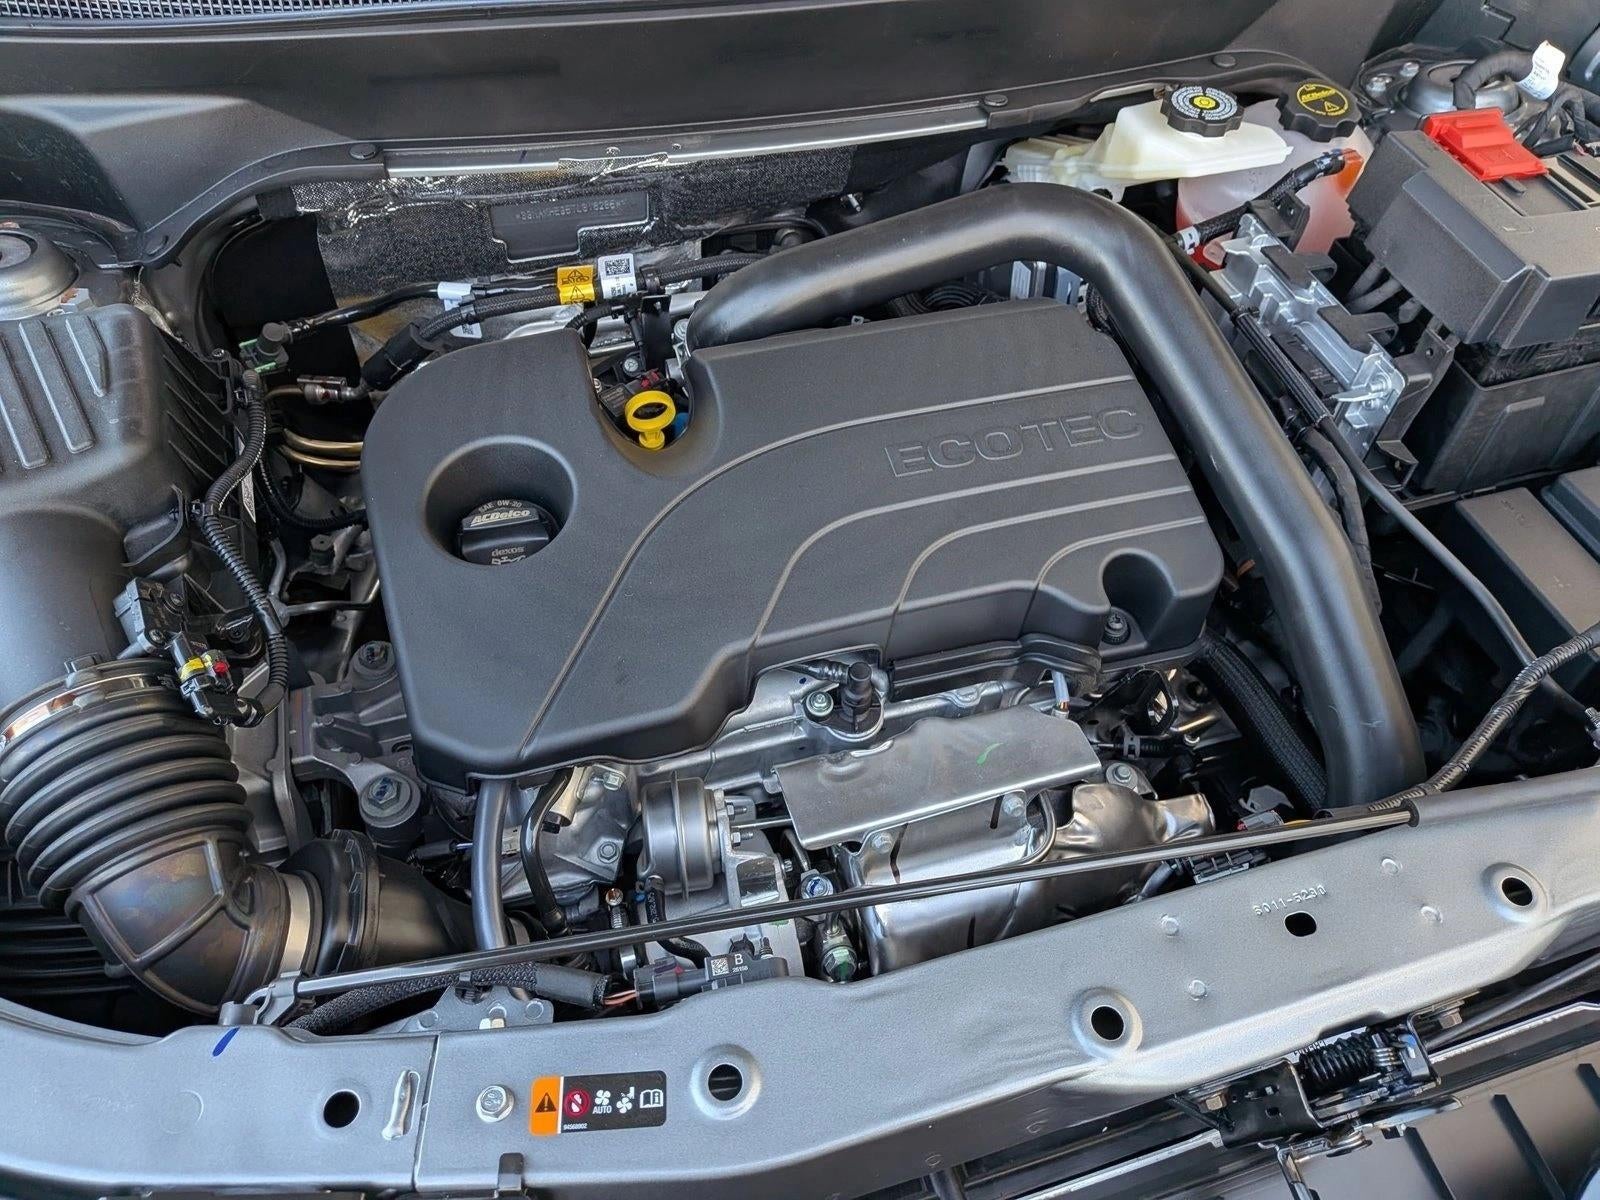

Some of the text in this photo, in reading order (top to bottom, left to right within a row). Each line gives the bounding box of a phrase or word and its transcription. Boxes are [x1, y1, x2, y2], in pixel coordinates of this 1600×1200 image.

[884, 409, 1144, 478] ECOTEC
[479, 499, 523, 513] SAE 0W-20
[470, 509, 531, 527] ACDelco
[491, 546, 525, 557] dexos
[734, 953, 744, 965] B
[592, 1105, 612, 1114] AUTO
